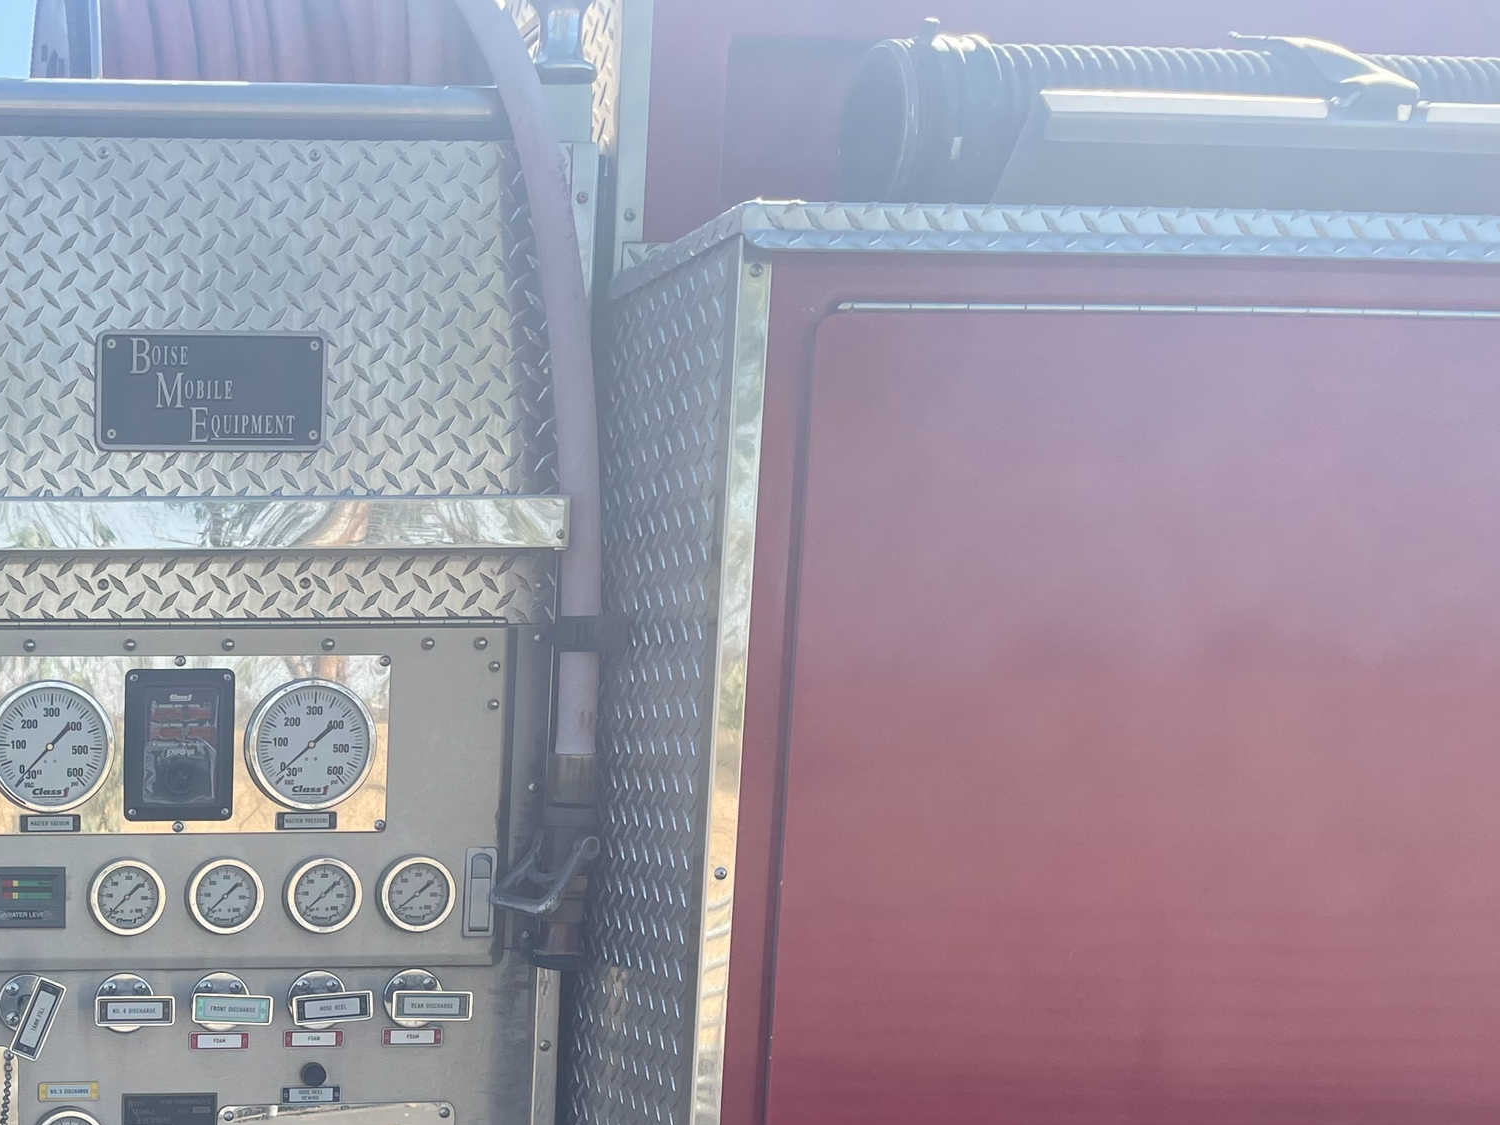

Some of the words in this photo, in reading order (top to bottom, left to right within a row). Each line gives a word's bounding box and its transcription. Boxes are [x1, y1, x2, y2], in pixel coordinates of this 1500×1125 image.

[129, 337, 189, 374] BOISE
[154, 371, 233, 409] MOBILE
[189, 406, 296, 444] EQUIPMENT
[43, 708, 60, 717] 300
[306, 706, 323, 716] 300
[21, 719, 38, 729] 200
[67, 722, 82, 731] 400
[284, 717, 301, 727] 200
[327, 720, 344, 730] 400
[11, 740, 26, 749] 100
[273, 737, 288, 747] 100
[72, 745, 88, 755] 500
[333, 743, 349, 753] 500
[19, 765, 25, 774] 0
[280, 762, 286, 771] 0
[327, 766, 344, 775] 600
[67, 768, 83, 777] 600
